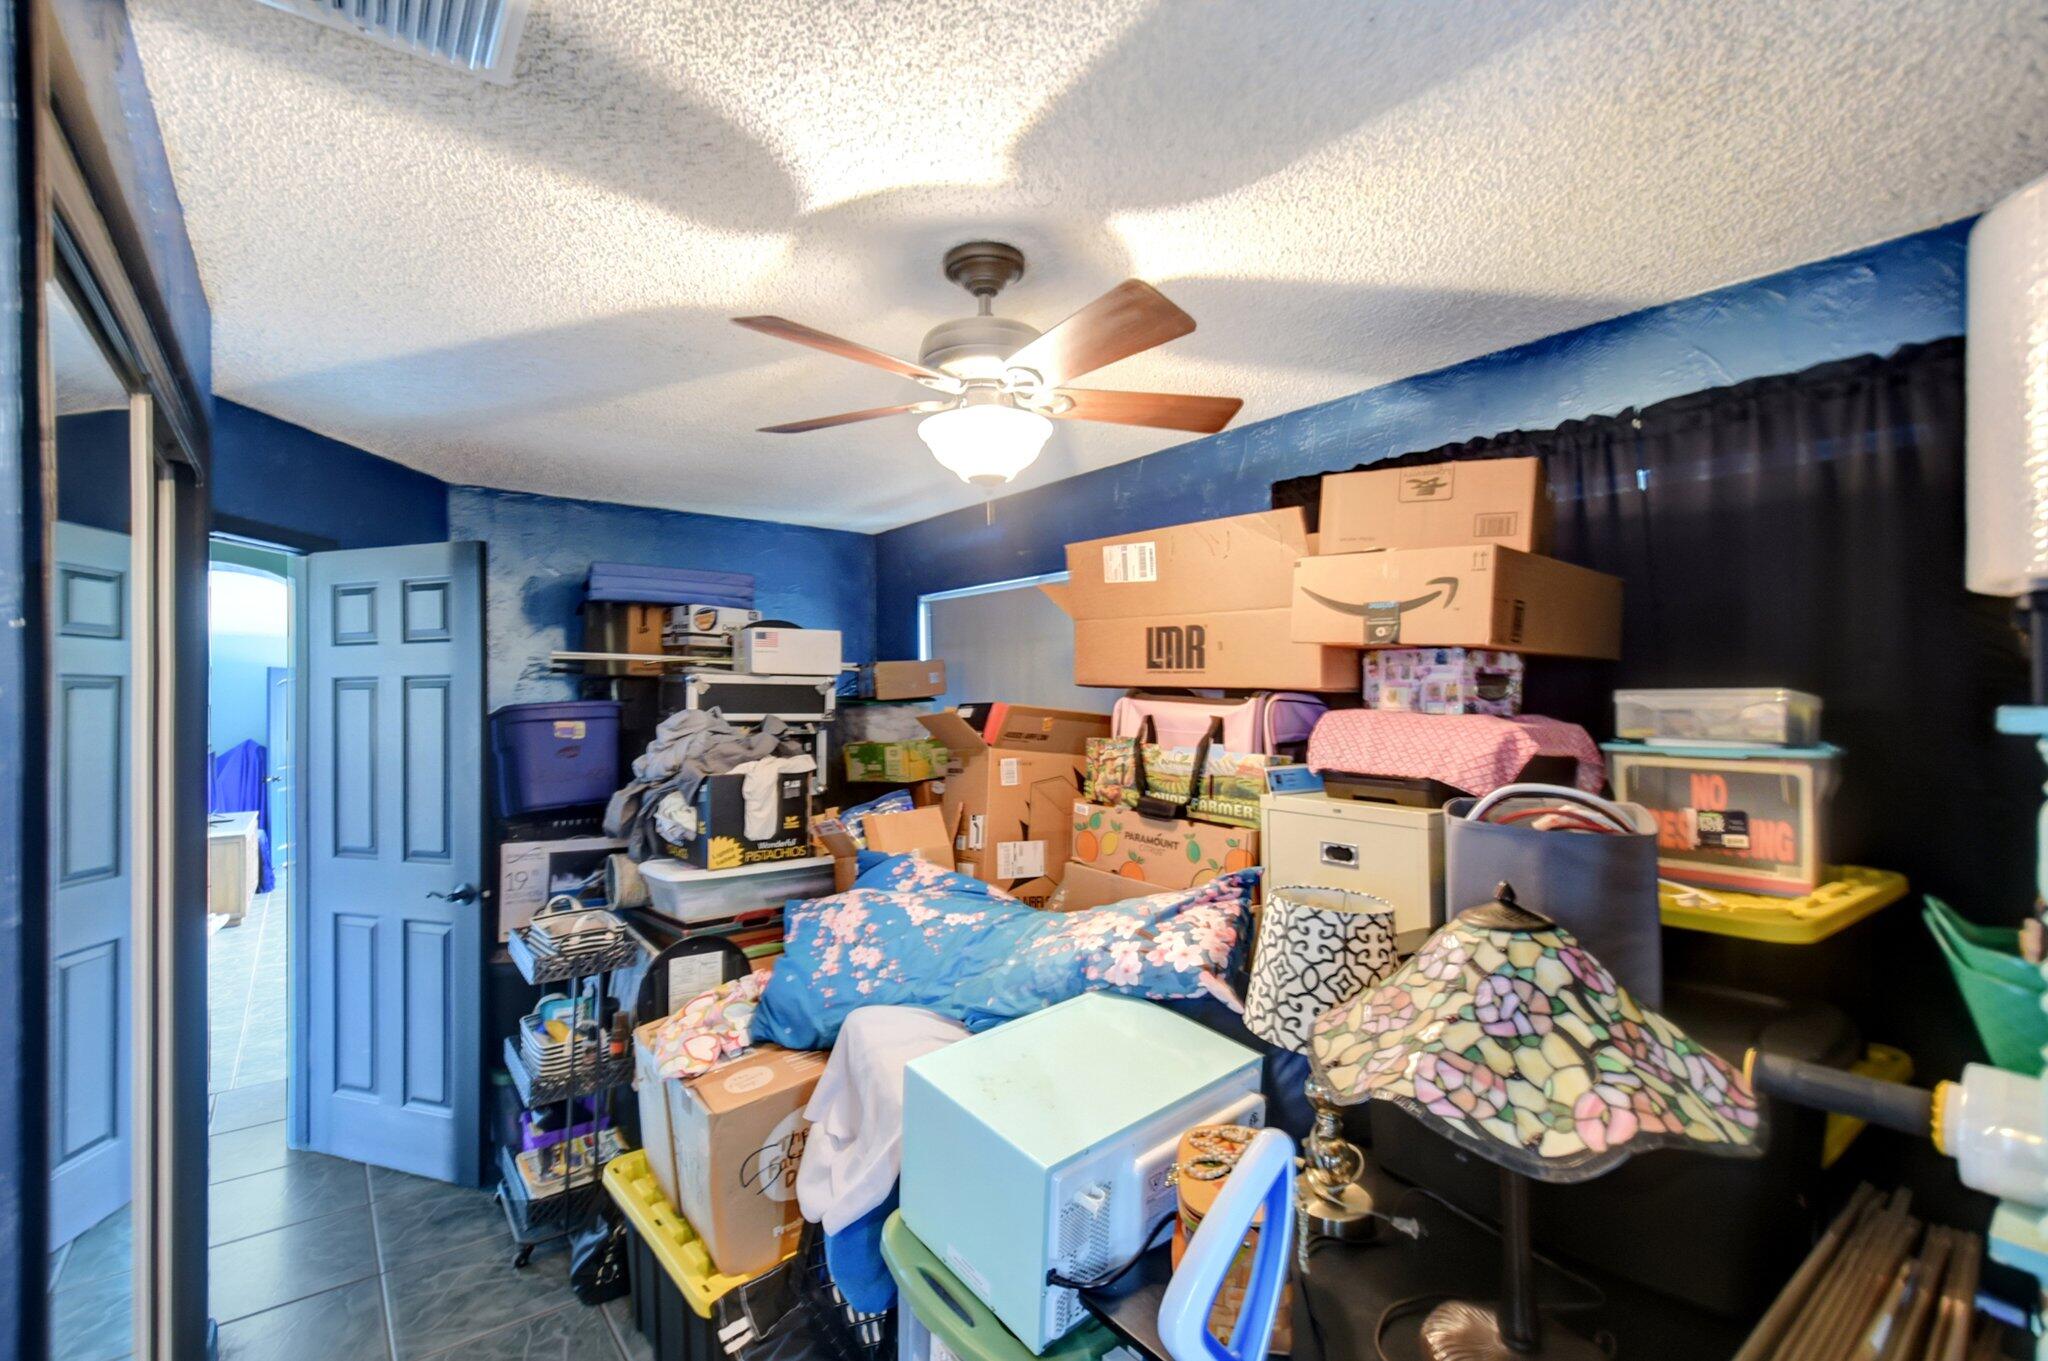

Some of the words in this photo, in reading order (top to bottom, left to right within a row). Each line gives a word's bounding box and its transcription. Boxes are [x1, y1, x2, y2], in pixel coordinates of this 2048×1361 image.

[1146, 624, 1205, 669] LMR
[1690, 773, 1728, 811] NO
[757, 838, 797, 850] Wonderful
[1124, 831, 1180, 850] PARAMOUNT
[745, 845, 806, 863] PISTACHIOS
[505, 871, 528, 891] 19
